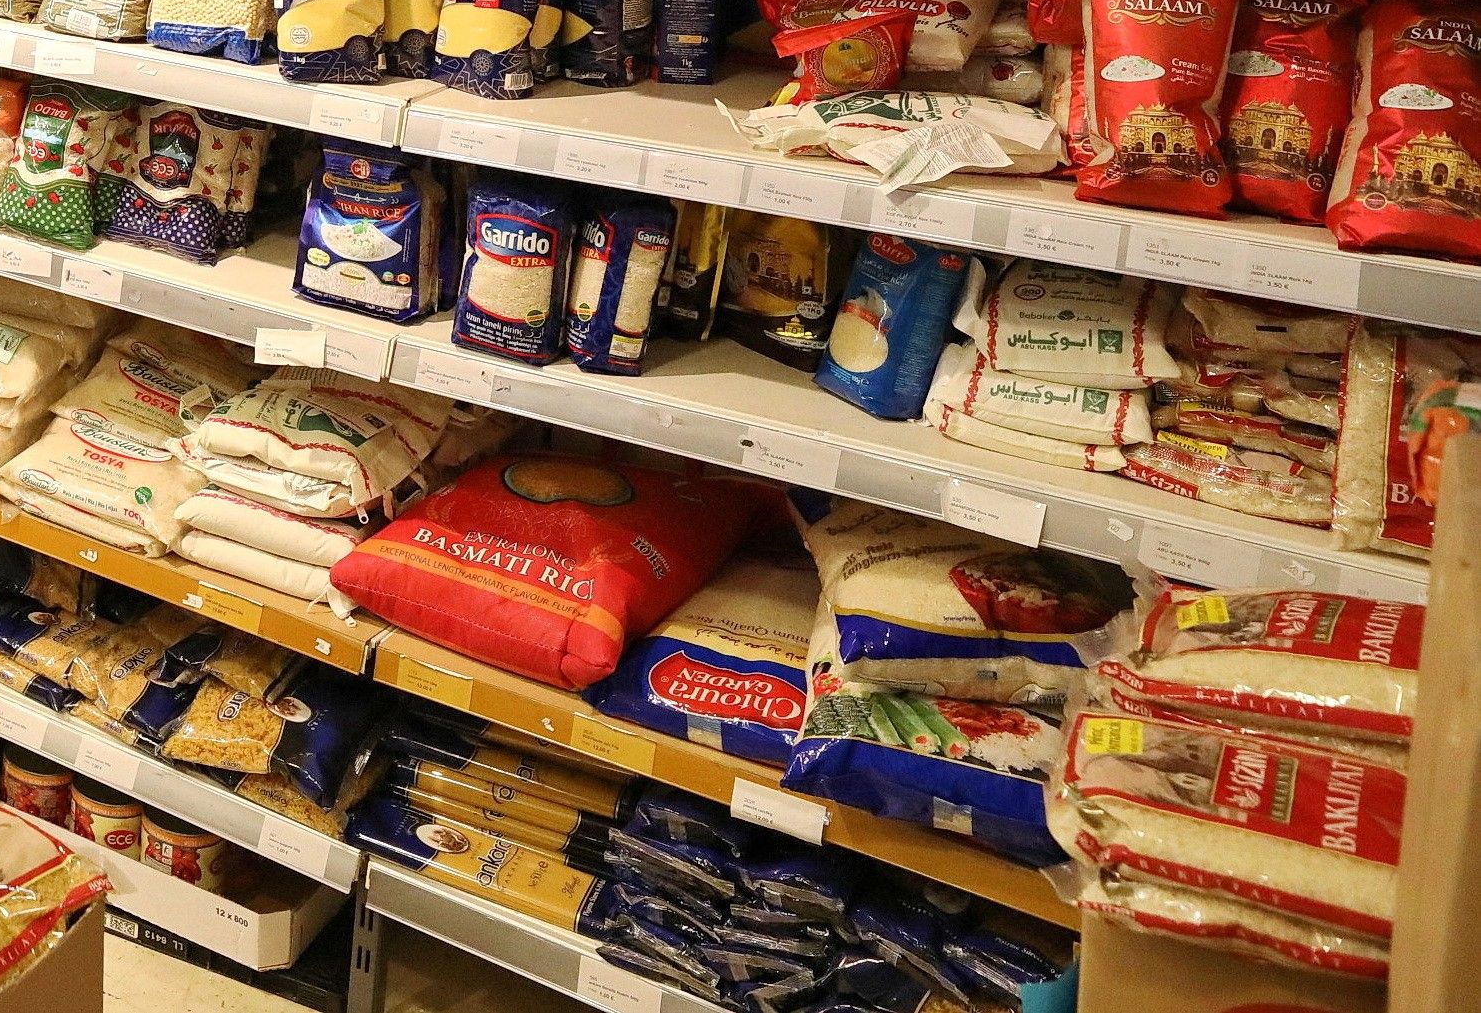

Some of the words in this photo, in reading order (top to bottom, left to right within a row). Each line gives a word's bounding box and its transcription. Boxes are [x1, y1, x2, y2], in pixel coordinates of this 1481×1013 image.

[1440, 20, 1471, 31] INDIA
[34, 102, 69, 118] BALDO
[373, 207, 401, 218] RICE
[480, 222, 550, 254] Garrido
[638, 230, 670, 246] Garrido
[510, 257, 546, 266] EXTRA
[134, 390, 178, 417] TOSYA
[82, 449, 124, 469] TOSYA
[412, 527, 531, 577] BASMATI
[464, 528, 520, 552] EXTRA
[523, 541, 577, 573] LONG
[677, 667, 775, 694] GARDEN
[669, 681, 803, 726] Chtoura
[1320, 757, 1365, 854] BAKLIYAT
[105, 832, 134, 847] ECE
[216, 908, 228, 918] 12
[234, 914, 249, 928] 800
